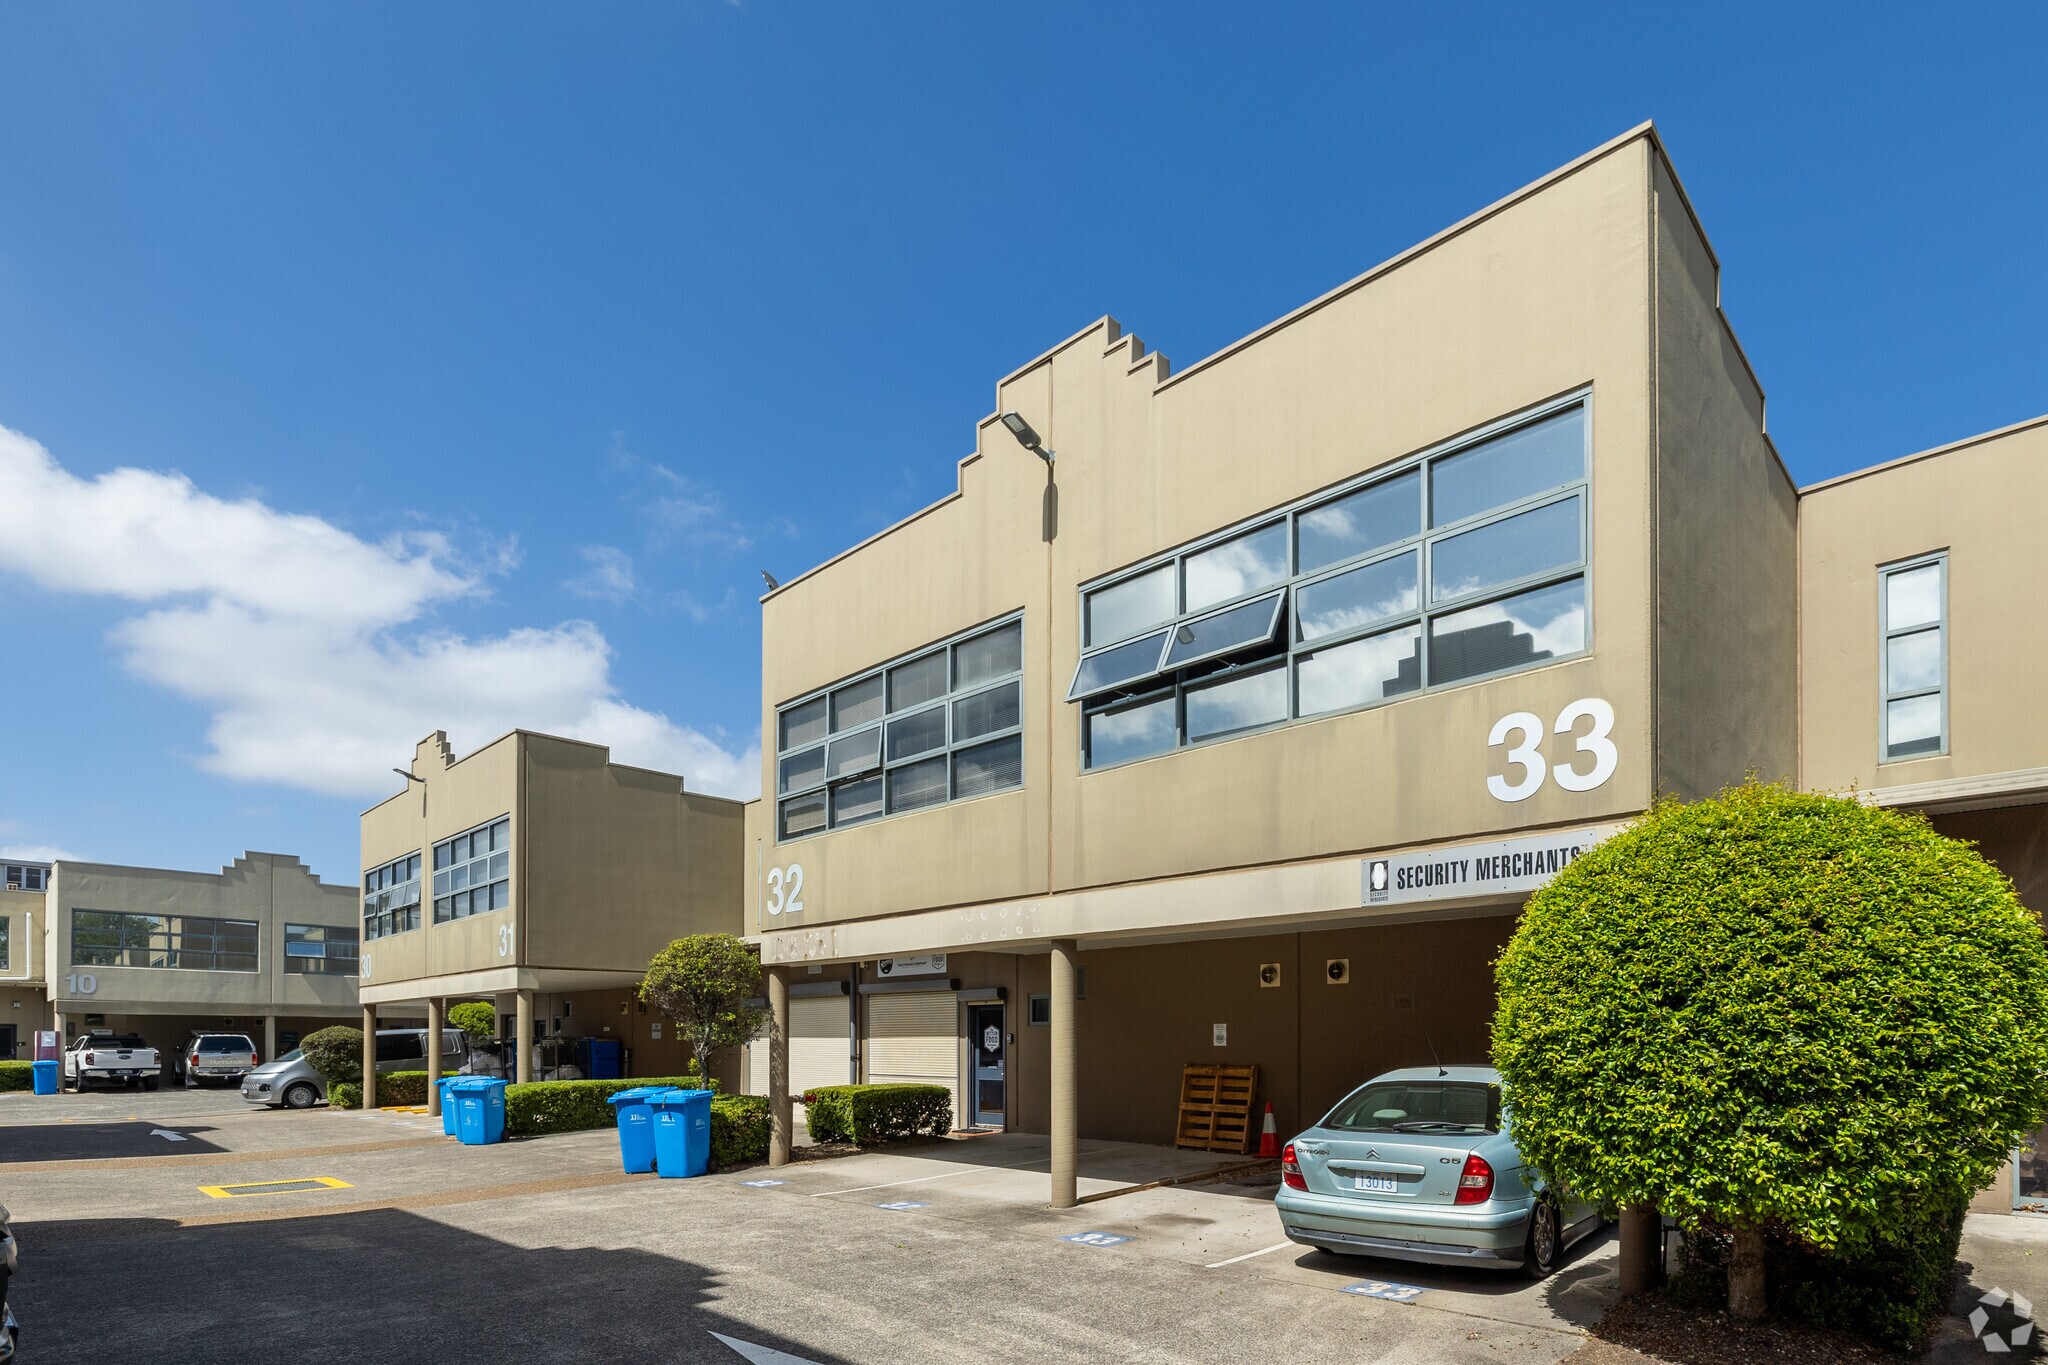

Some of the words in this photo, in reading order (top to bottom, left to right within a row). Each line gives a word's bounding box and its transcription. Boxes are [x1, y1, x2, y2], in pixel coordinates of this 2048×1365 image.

[1486, 697, 1618, 803] 33
[1396, 859, 1469, 890] SECURITY
[766, 863, 804, 916] 32
[499, 923, 515, 957] 31
[360, 953, 372, 979] 30
[64, 973, 97, 994] 10
[1360, 1175, 1393, 1190] 13013
[1070, 1233, 1121, 1245] 33
[1355, 1281, 1422, 1299] 33
